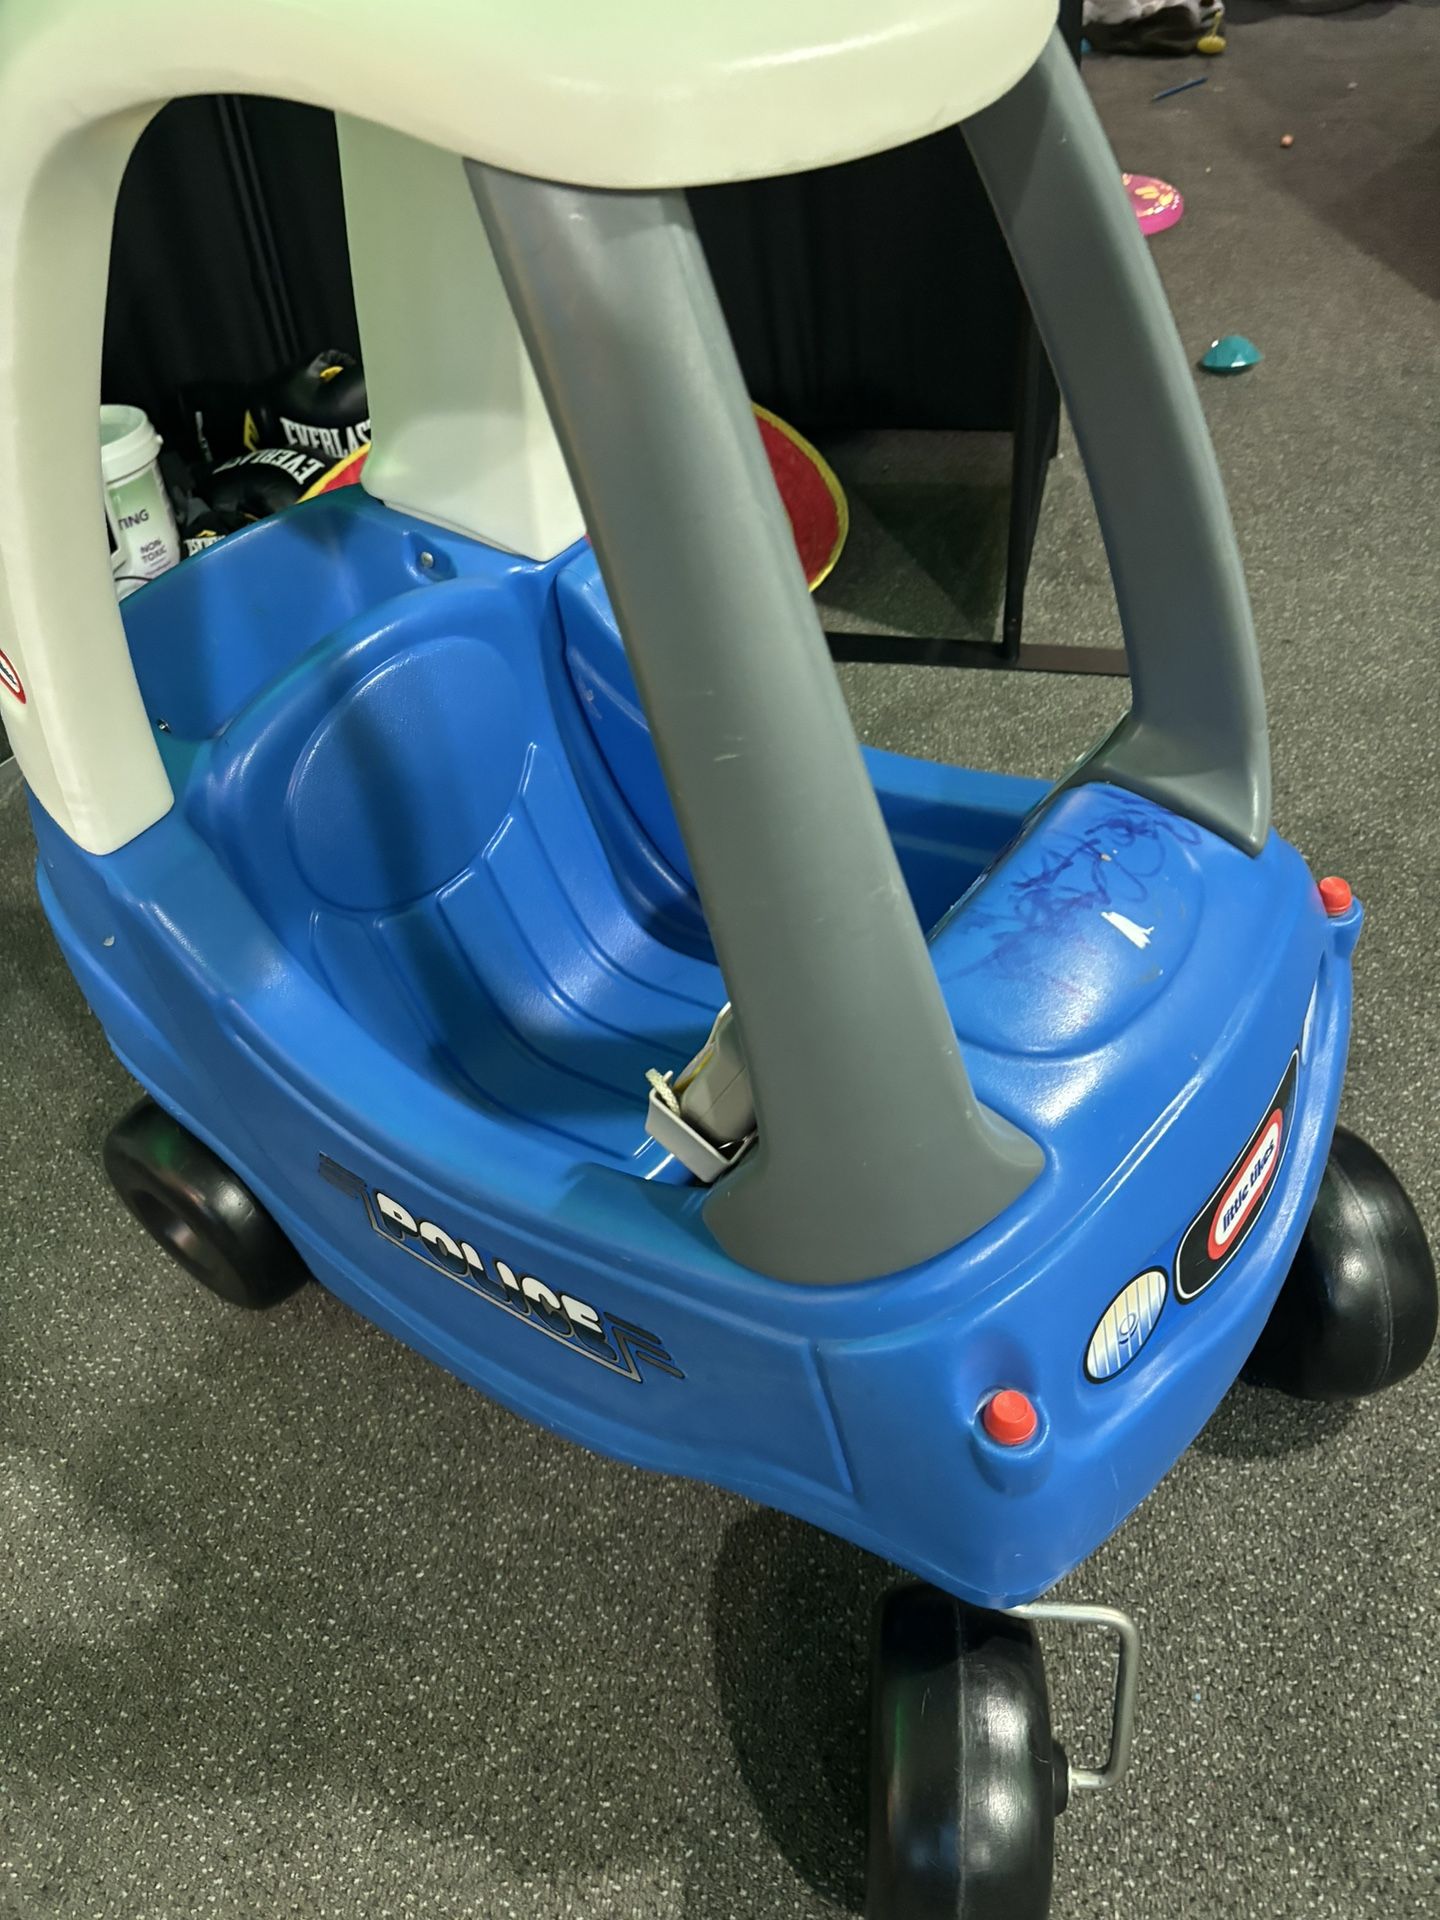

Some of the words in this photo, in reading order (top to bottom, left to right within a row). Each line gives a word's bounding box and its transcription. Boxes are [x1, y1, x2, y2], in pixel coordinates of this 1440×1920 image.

[279, 416, 372, 458] EVERLAS
[1223, 1184, 1249, 1232] little
[1250, 1139, 1275, 1188] tikes
[376, 1191, 619, 1363] POLICE
